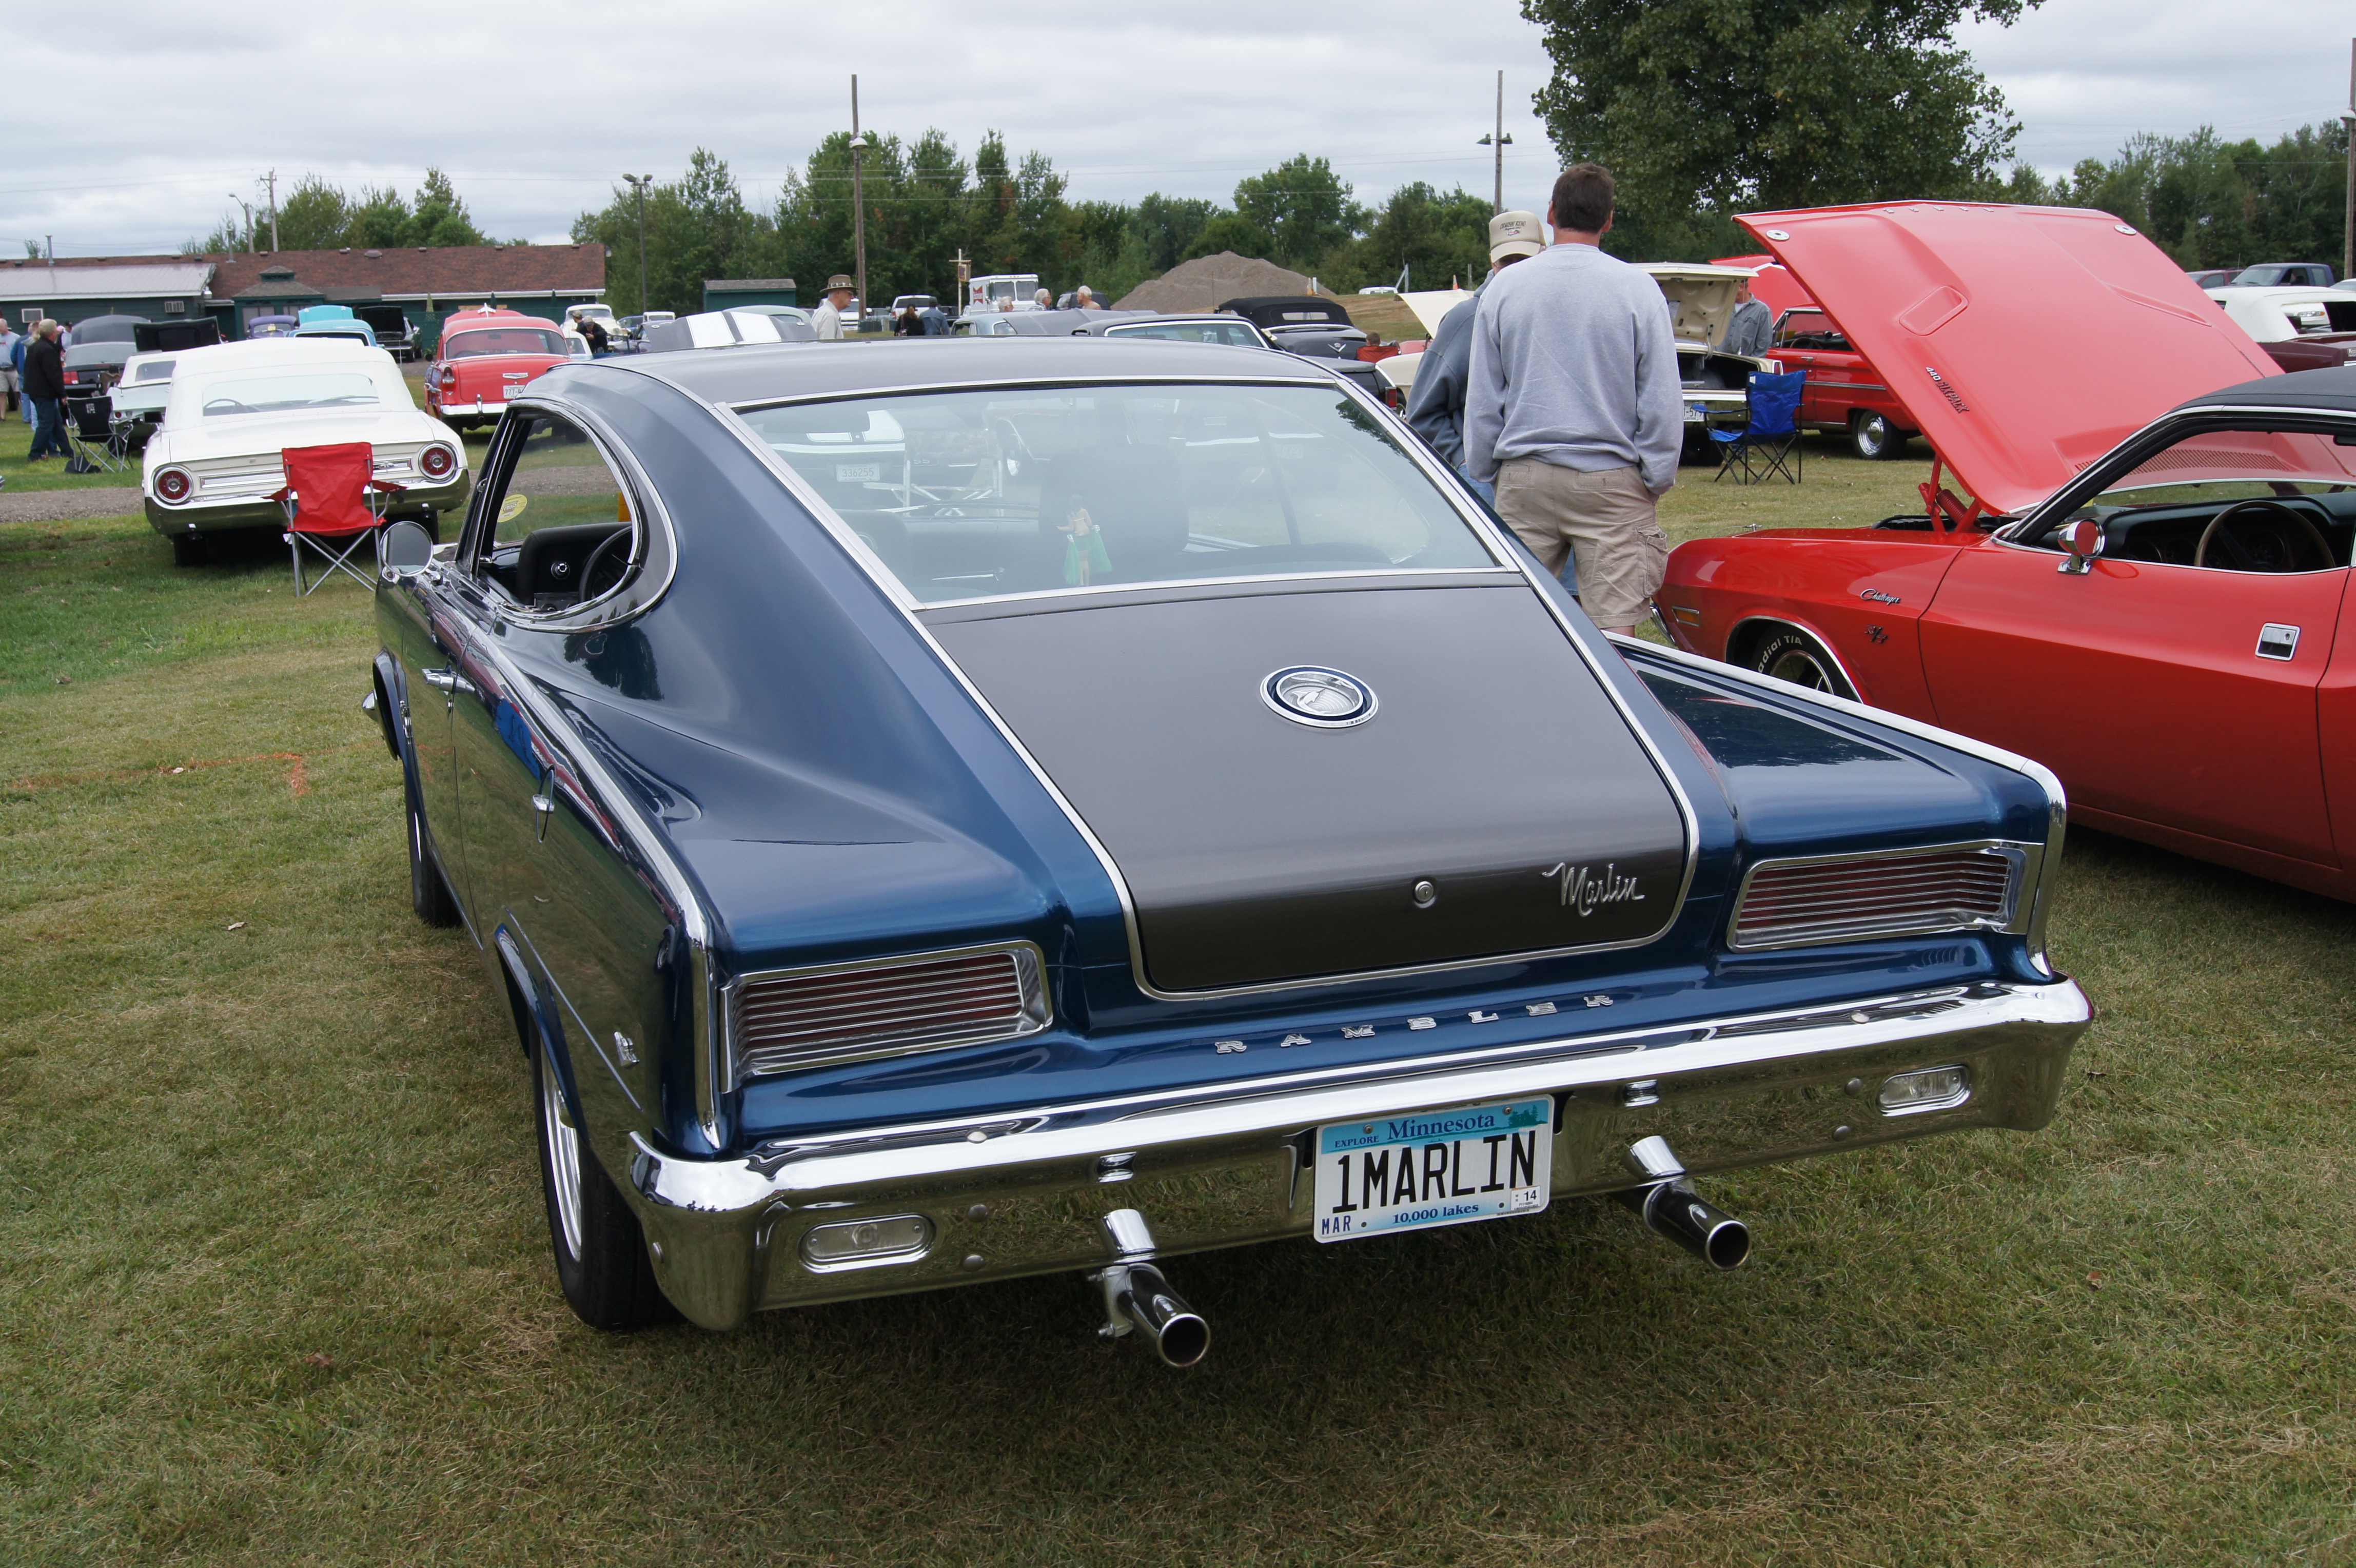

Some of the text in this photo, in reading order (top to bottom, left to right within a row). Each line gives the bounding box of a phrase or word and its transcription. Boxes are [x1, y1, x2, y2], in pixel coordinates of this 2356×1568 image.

[1926, 367, 1941, 381] 440
[842, 467, 874, 477] 336255
[1860, 588, 1901, 605] Challenger
[1863, 624, 1889, 644] R/T
[1757, 638, 1781, 673] adial
[1541, 862, 1645, 917] Marlin
[1214, 994, 1614, 1054] RAMBLER
[1334, 1114, 1495, 1148] EXPLORE Minnesota
[1332, 1130, 1536, 1214] 1MARLIN
[1523, 1189, 1537, 1201] 14
[1392, 1204, 1479, 1224] 10,000 lakes
[1321, 1215, 1351, 1235] MAR
